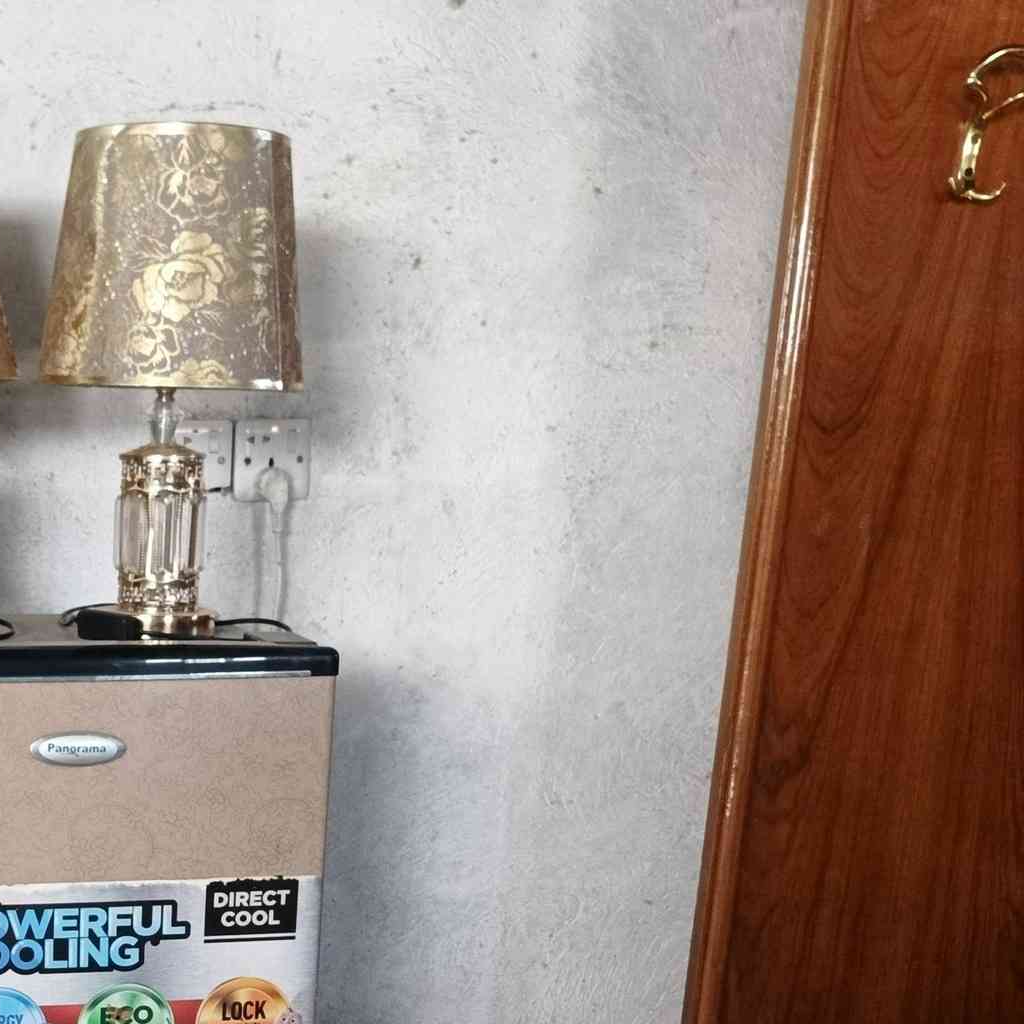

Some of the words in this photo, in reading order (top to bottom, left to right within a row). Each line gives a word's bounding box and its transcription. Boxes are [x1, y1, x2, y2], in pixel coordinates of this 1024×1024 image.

[47, 742, 107, 754] Panorama
[213, 889, 291, 909] DIRECT
[220, 909, 281, 927] COOL
[221, 1000, 267, 1021] LOCK
